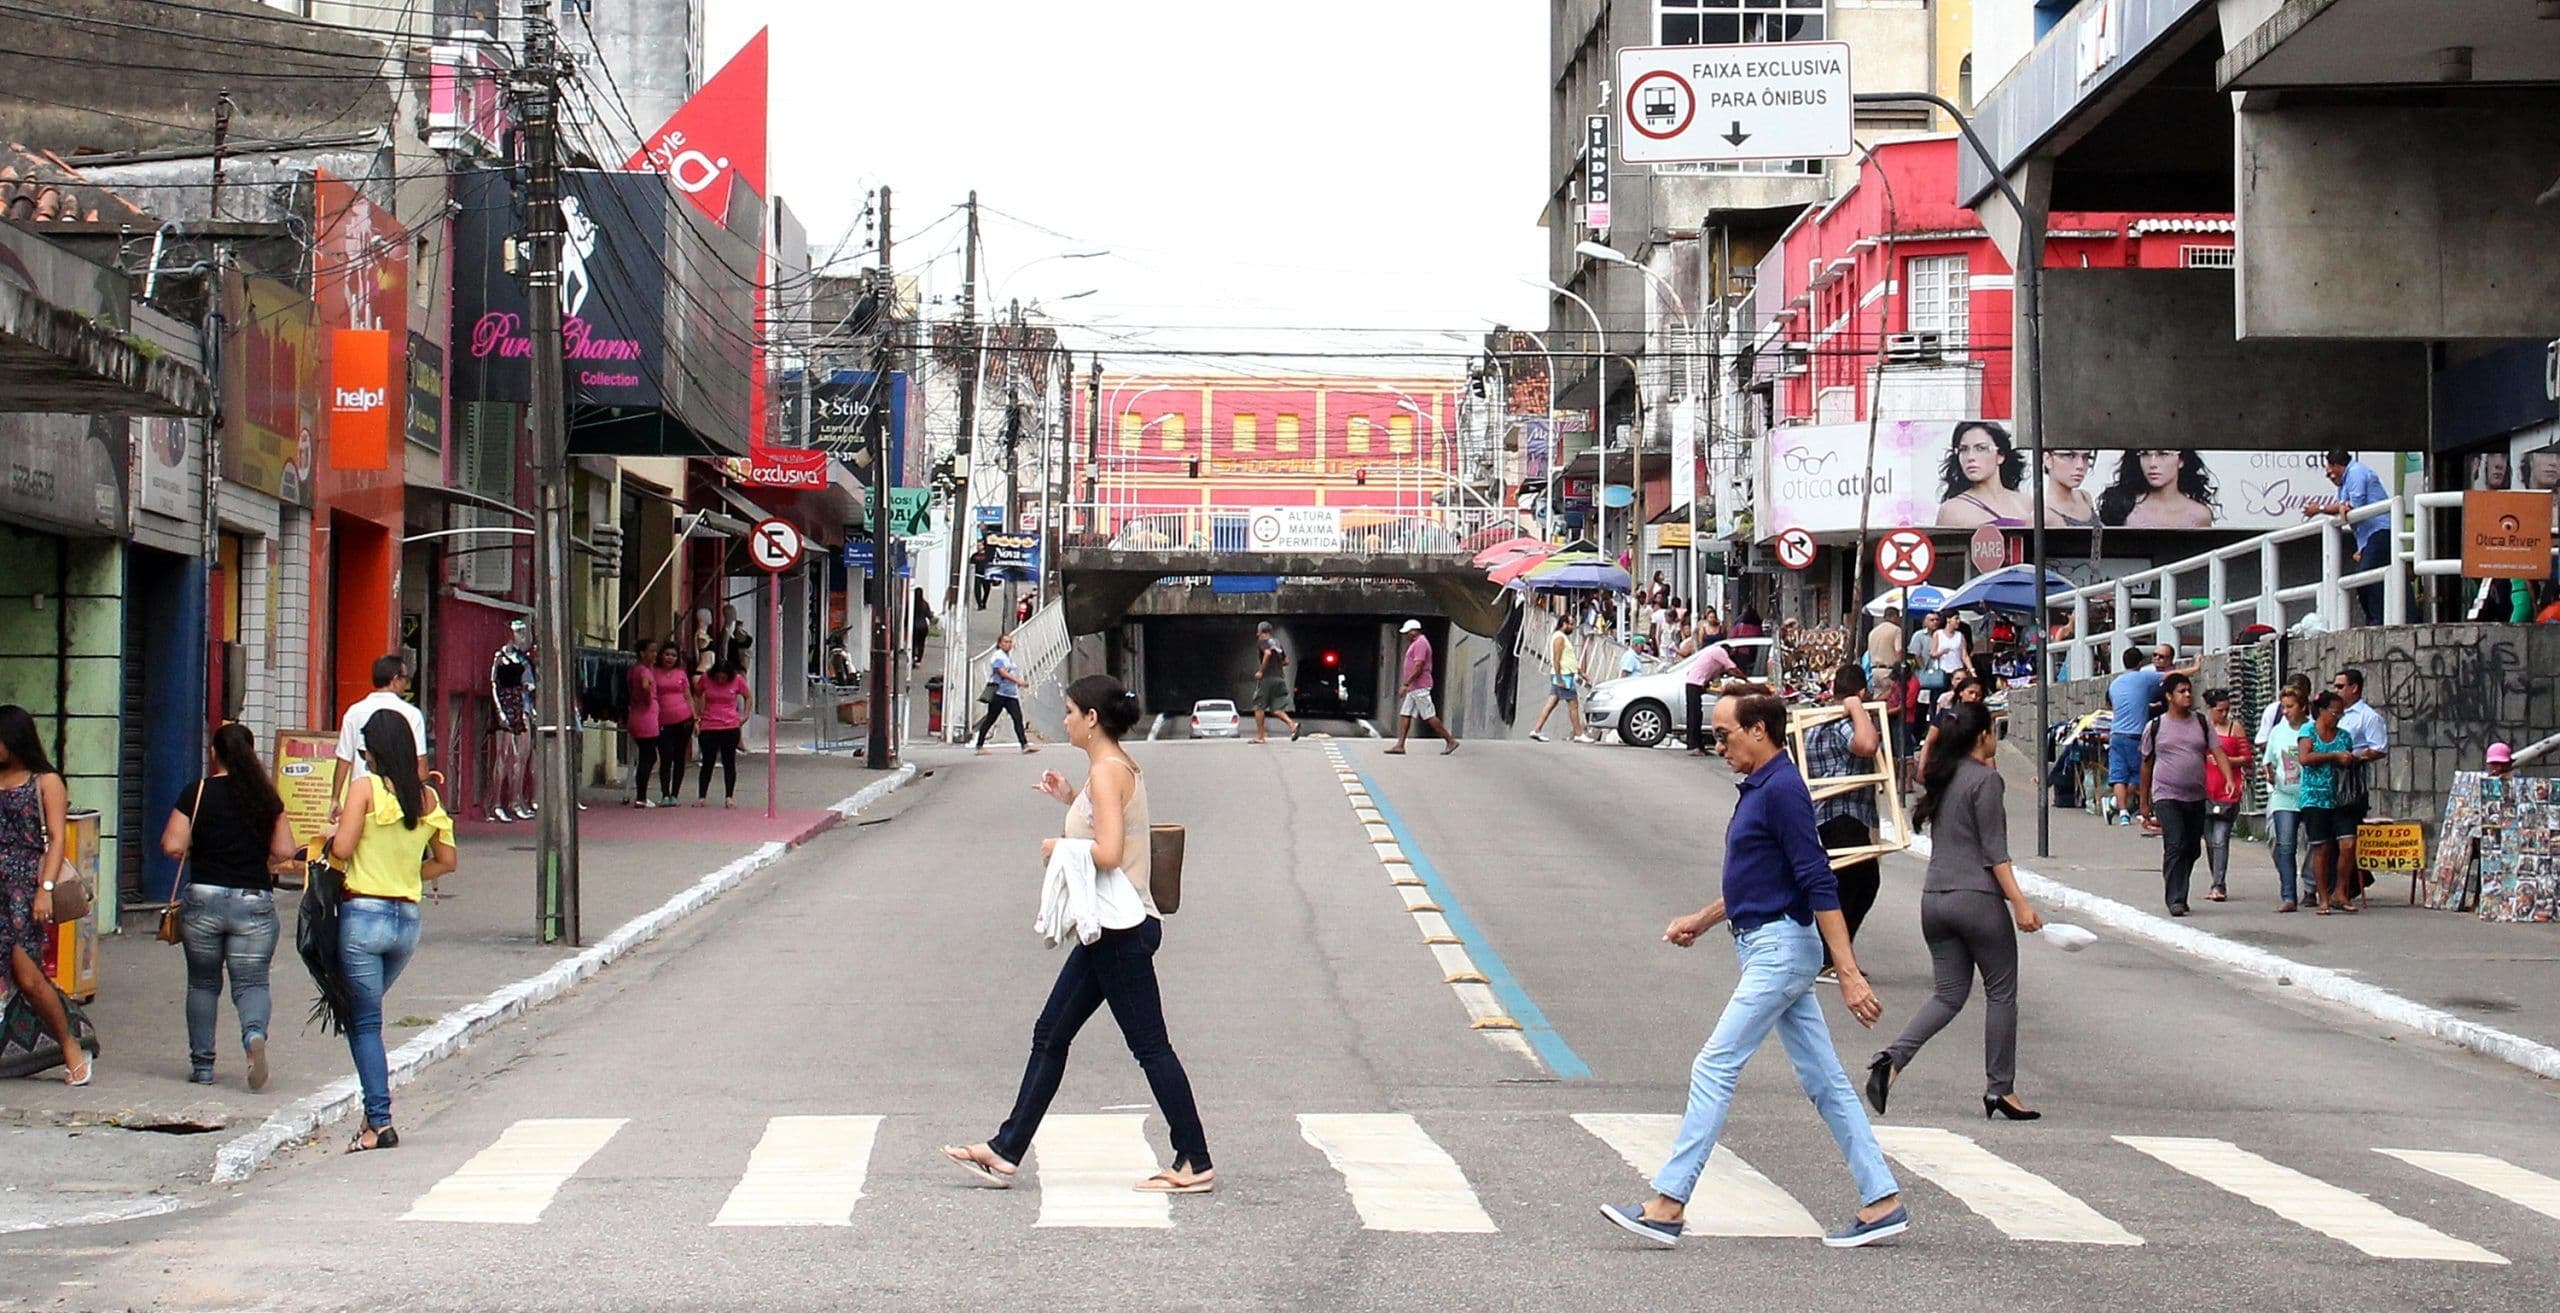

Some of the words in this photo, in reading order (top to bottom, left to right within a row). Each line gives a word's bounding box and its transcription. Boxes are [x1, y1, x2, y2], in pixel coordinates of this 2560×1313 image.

[1692, 62, 1741, 79] FAIXA
[1746, 59, 1842, 78] EXCLUSIVA
[1711, 91, 1758, 108] PARA
[1762, 87, 1828, 106] ÔNIBUS
[1590, 117, 1607, 202] SINDPD
[562, 312, 642, 360] Charm
[581, 371, 639, 387] Collection
[335, 387, 385, 411] help!
[832, 401, 870, 416] Stilo
[1288, 511, 1332, 521] ALTURA
[1288, 524, 1334, 535] MÁXIMA
[1279, 537, 1339, 548] PERMITIDA
[2509, 534, 2541, 547] River
[1974, 541, 2003, 558] PARE
[2359, 829, 2382, 837] DVD
